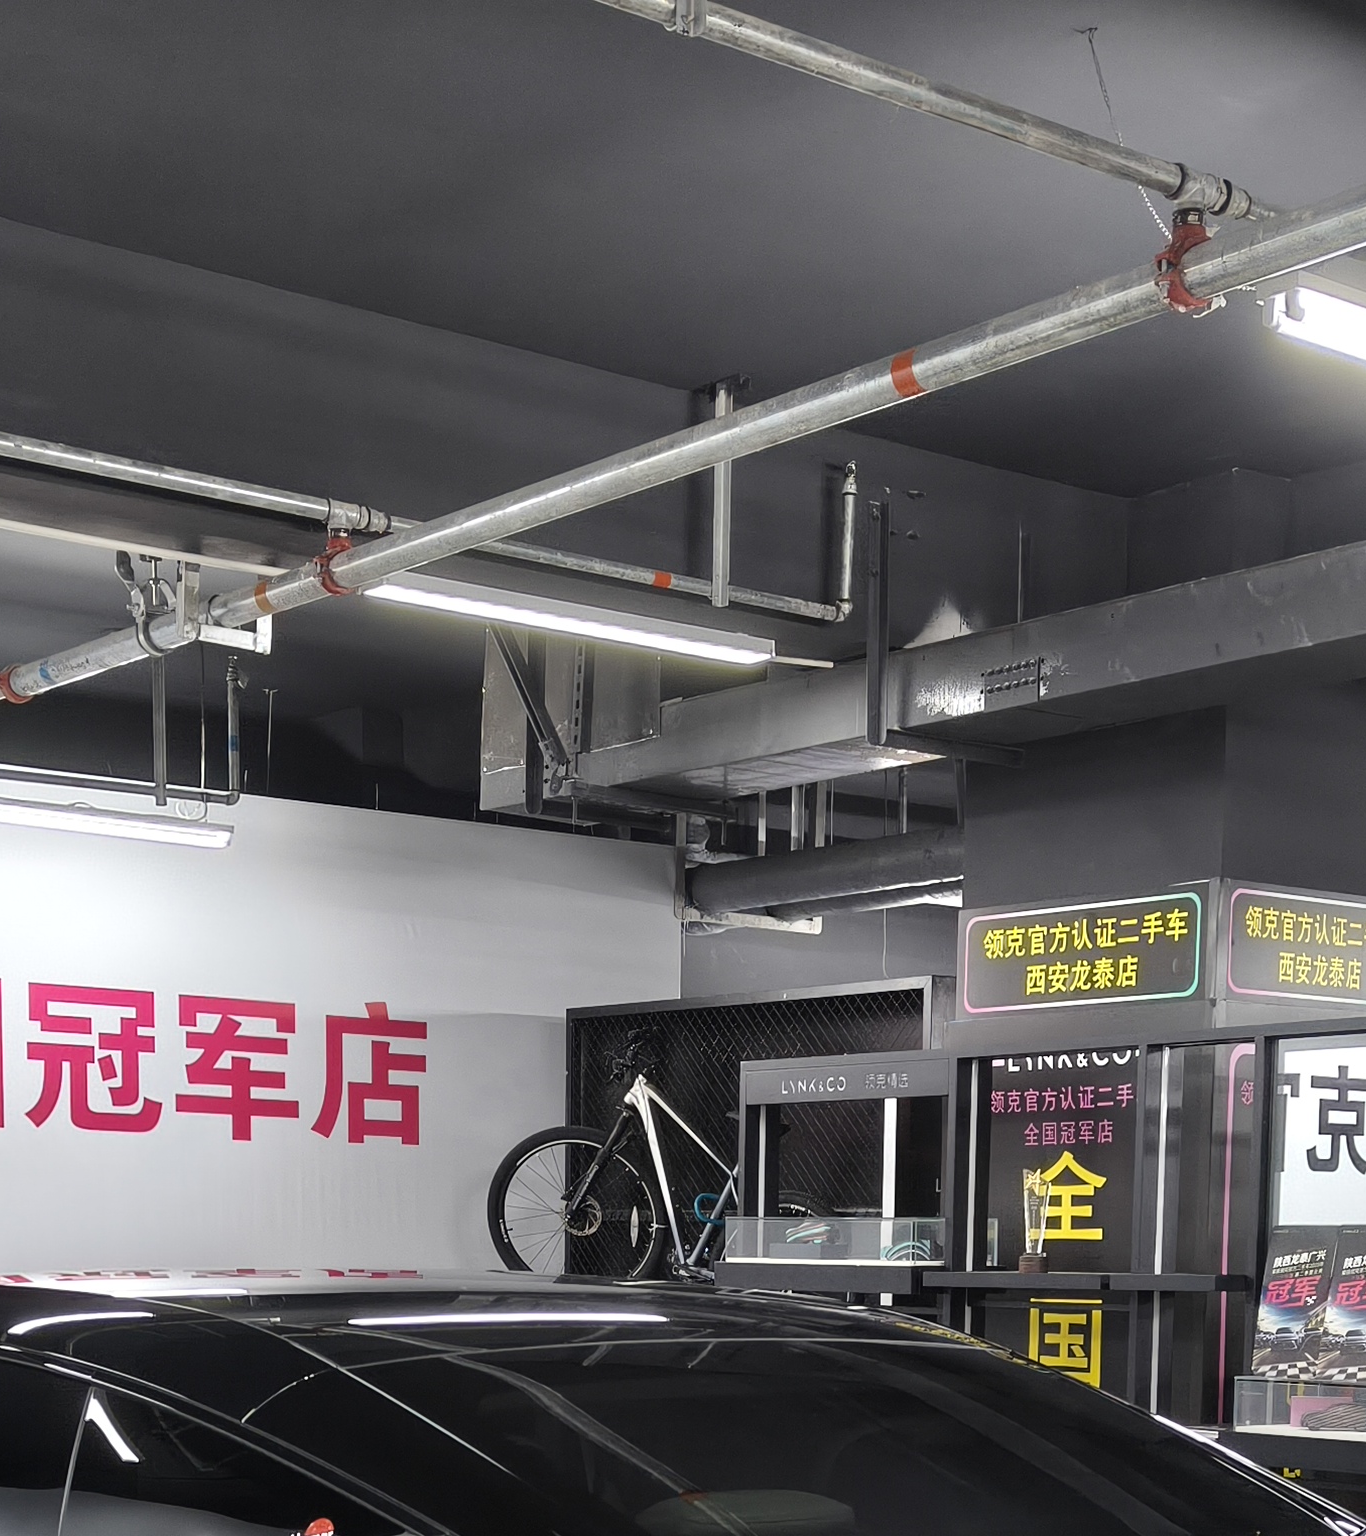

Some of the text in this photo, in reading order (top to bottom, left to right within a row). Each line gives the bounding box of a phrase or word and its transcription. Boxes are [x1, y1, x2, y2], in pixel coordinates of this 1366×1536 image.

[983, 908, 1189, 960] 领克官方认证二手车
[1025, 955, 1139, 996] 西安龙泰店
[1278, 952, 1362, 991] 西安龙泰店
[781, 1076, 847, 1095] LYNK&CO
[1023, 1118, 1114, 1147] 全国冠军店
[1264, 1276, 1322, 1309] 冠军
